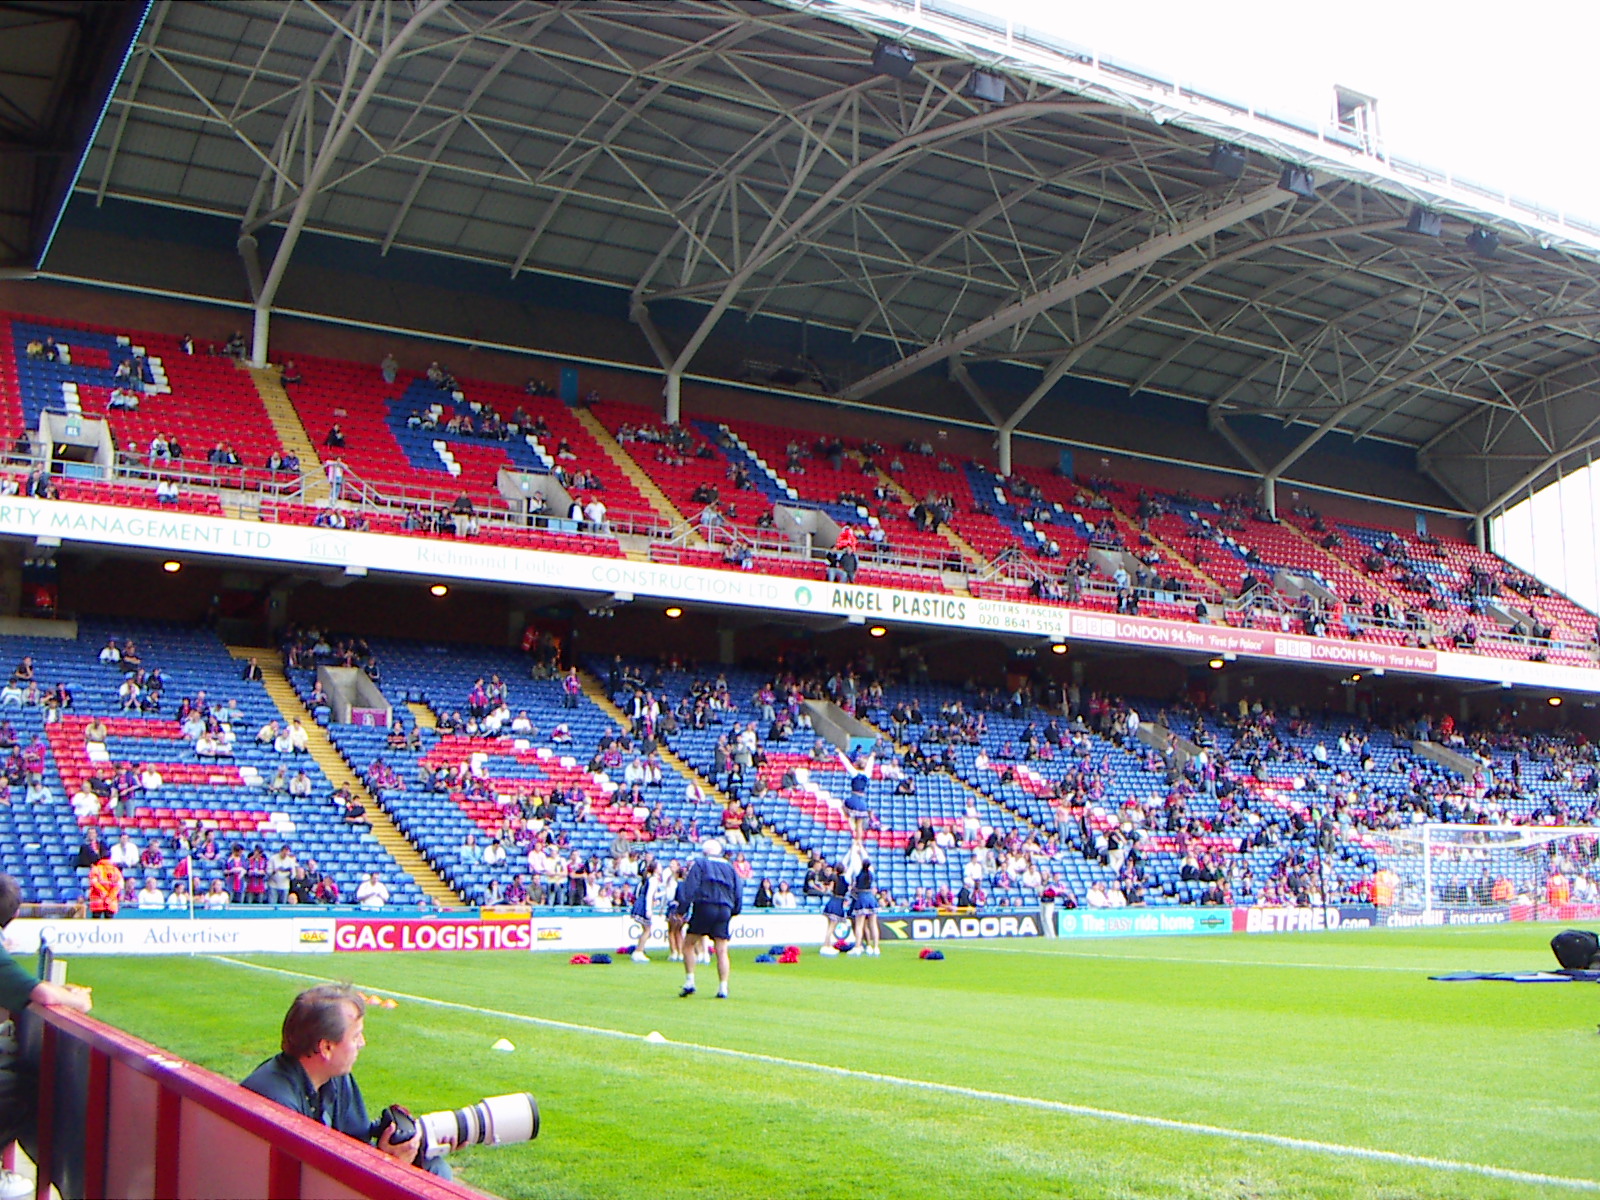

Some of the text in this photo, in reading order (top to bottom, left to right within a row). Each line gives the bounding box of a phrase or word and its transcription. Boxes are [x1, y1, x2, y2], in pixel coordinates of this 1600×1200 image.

[0, 505, 272, 549] RTY MANAGEMENT LTD
[416, 545, 507, 570] Richmond
[591, 565, 779, 600] CONSTRUCTION LTD
[831, 588, 966, 620] ANGEL PLASTICS
[978, 614, 1062, 633] 020 8641 5154
[1072, 615, 1116, 637] BBC
[1117, 623, 1170, 643] LONDON
[1275, 638, 1312, 658] BBC
[1312, 644, 1357, 661] LONDON
[912, 916, 1038, 939] DIADORA
[1081, 913, 1195, 932] The EASY ride home
[39, 925, 240, 947] Croydon Advertiser
[336, 924, 530, 949] GAC LOGISTICS
